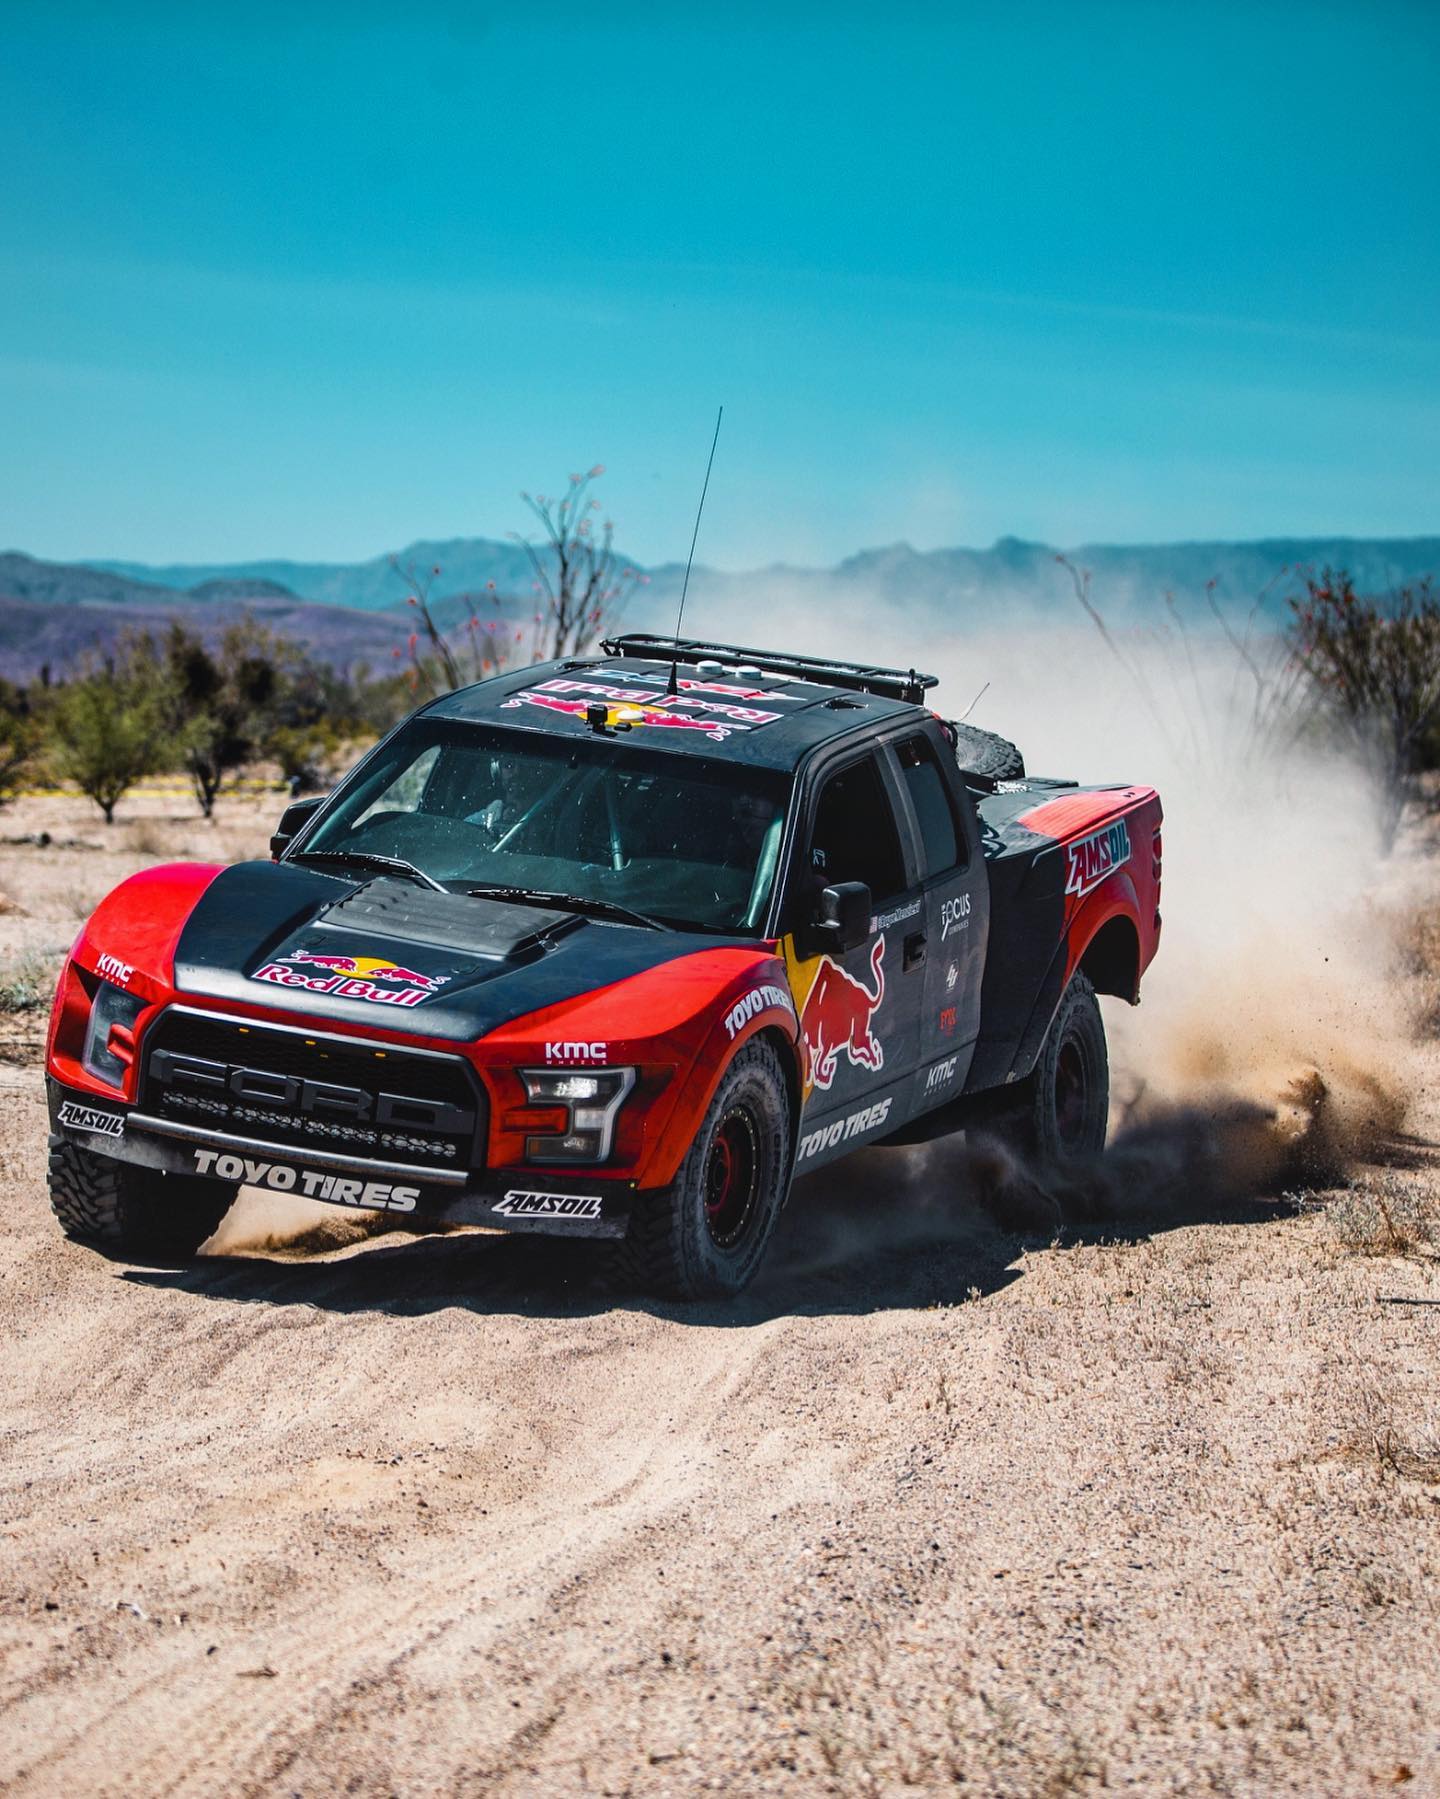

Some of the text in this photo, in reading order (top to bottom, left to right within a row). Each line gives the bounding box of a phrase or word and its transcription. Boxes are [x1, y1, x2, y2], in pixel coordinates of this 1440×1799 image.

[531, 679, 665, 703] Bull
[652, 694, 785, 724] Red
[1064, 817, 1131, 898] AMSOIL
[251, 963, 432, 1007] Red Bull
[724, 989, 764, 1041] TOYO
[150, 1048, 475, 1135] FORD
[57, 1100, 125, 1138] AMSOIL
[797, 1097, 893, 1162] TOYO TIRES
[194, 1149, 421, 1213] TOYO TIRES
[491, 1190, 602, 1219] AMSOIL
